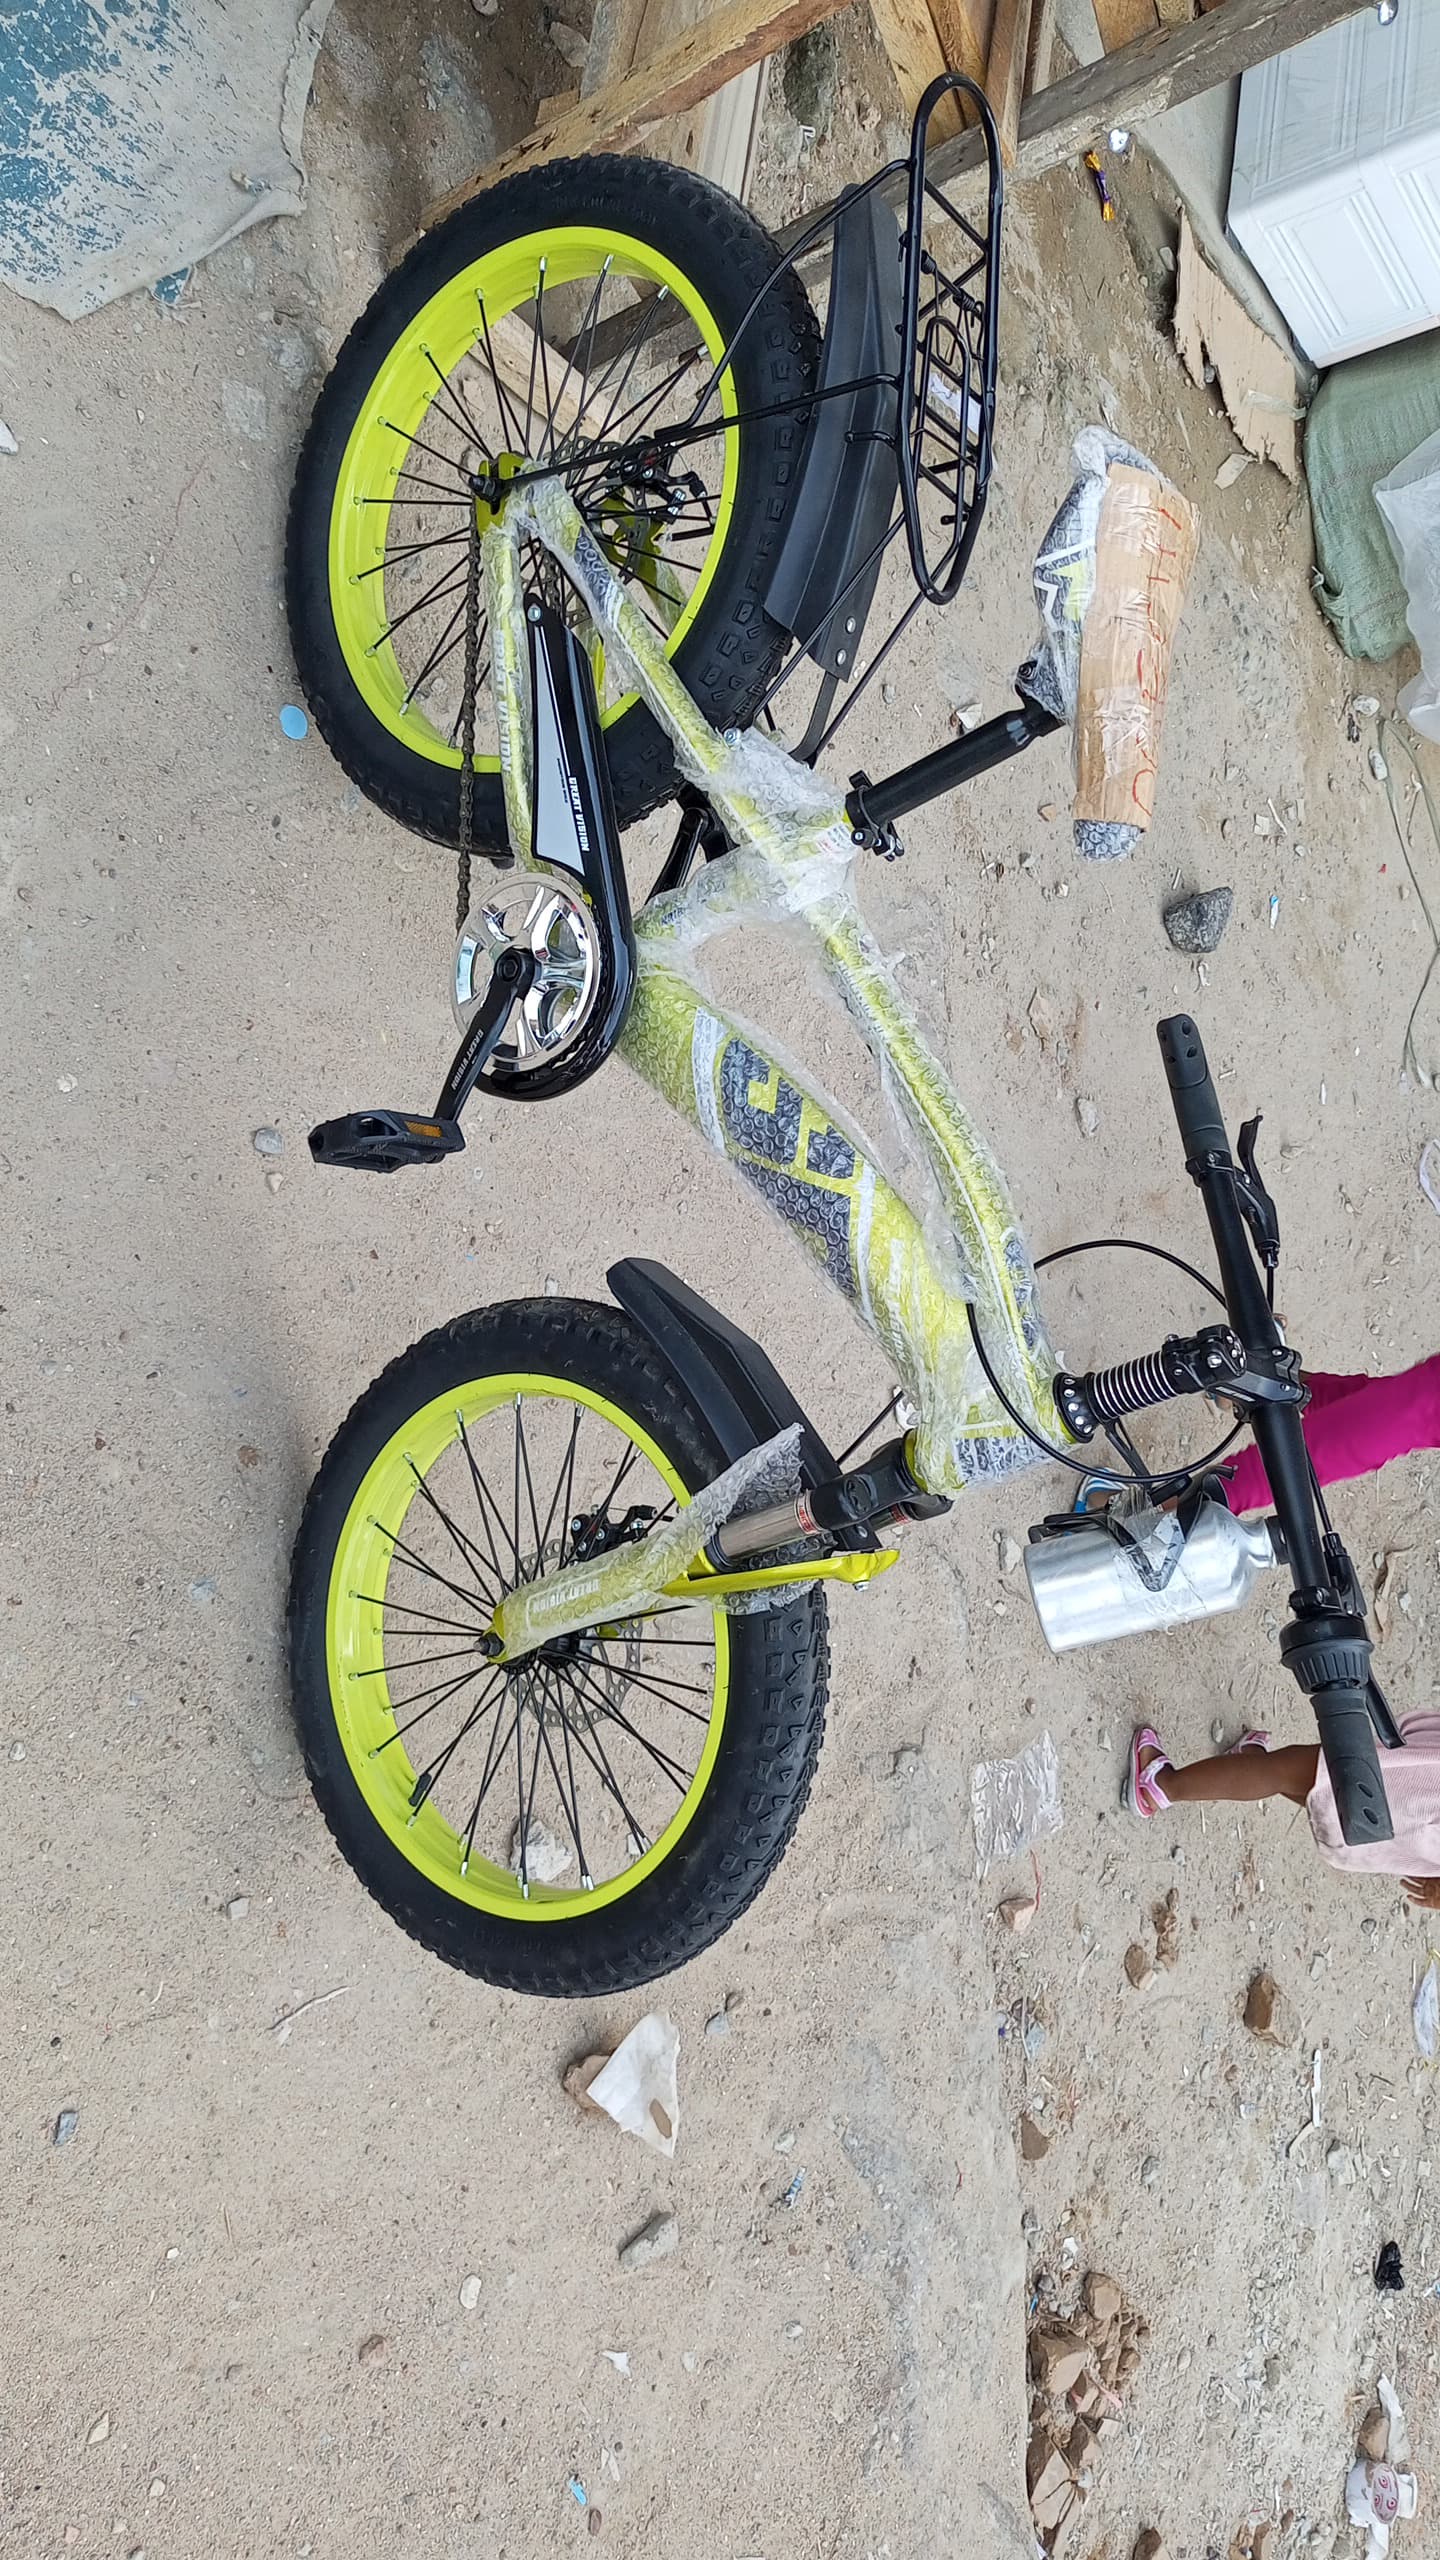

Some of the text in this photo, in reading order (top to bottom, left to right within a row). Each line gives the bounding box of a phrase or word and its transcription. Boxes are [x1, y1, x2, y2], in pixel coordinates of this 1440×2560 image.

[569, 777, 590, 851] GREAT VISION
[451, 1029, 484, 1090] GREAT VISION
